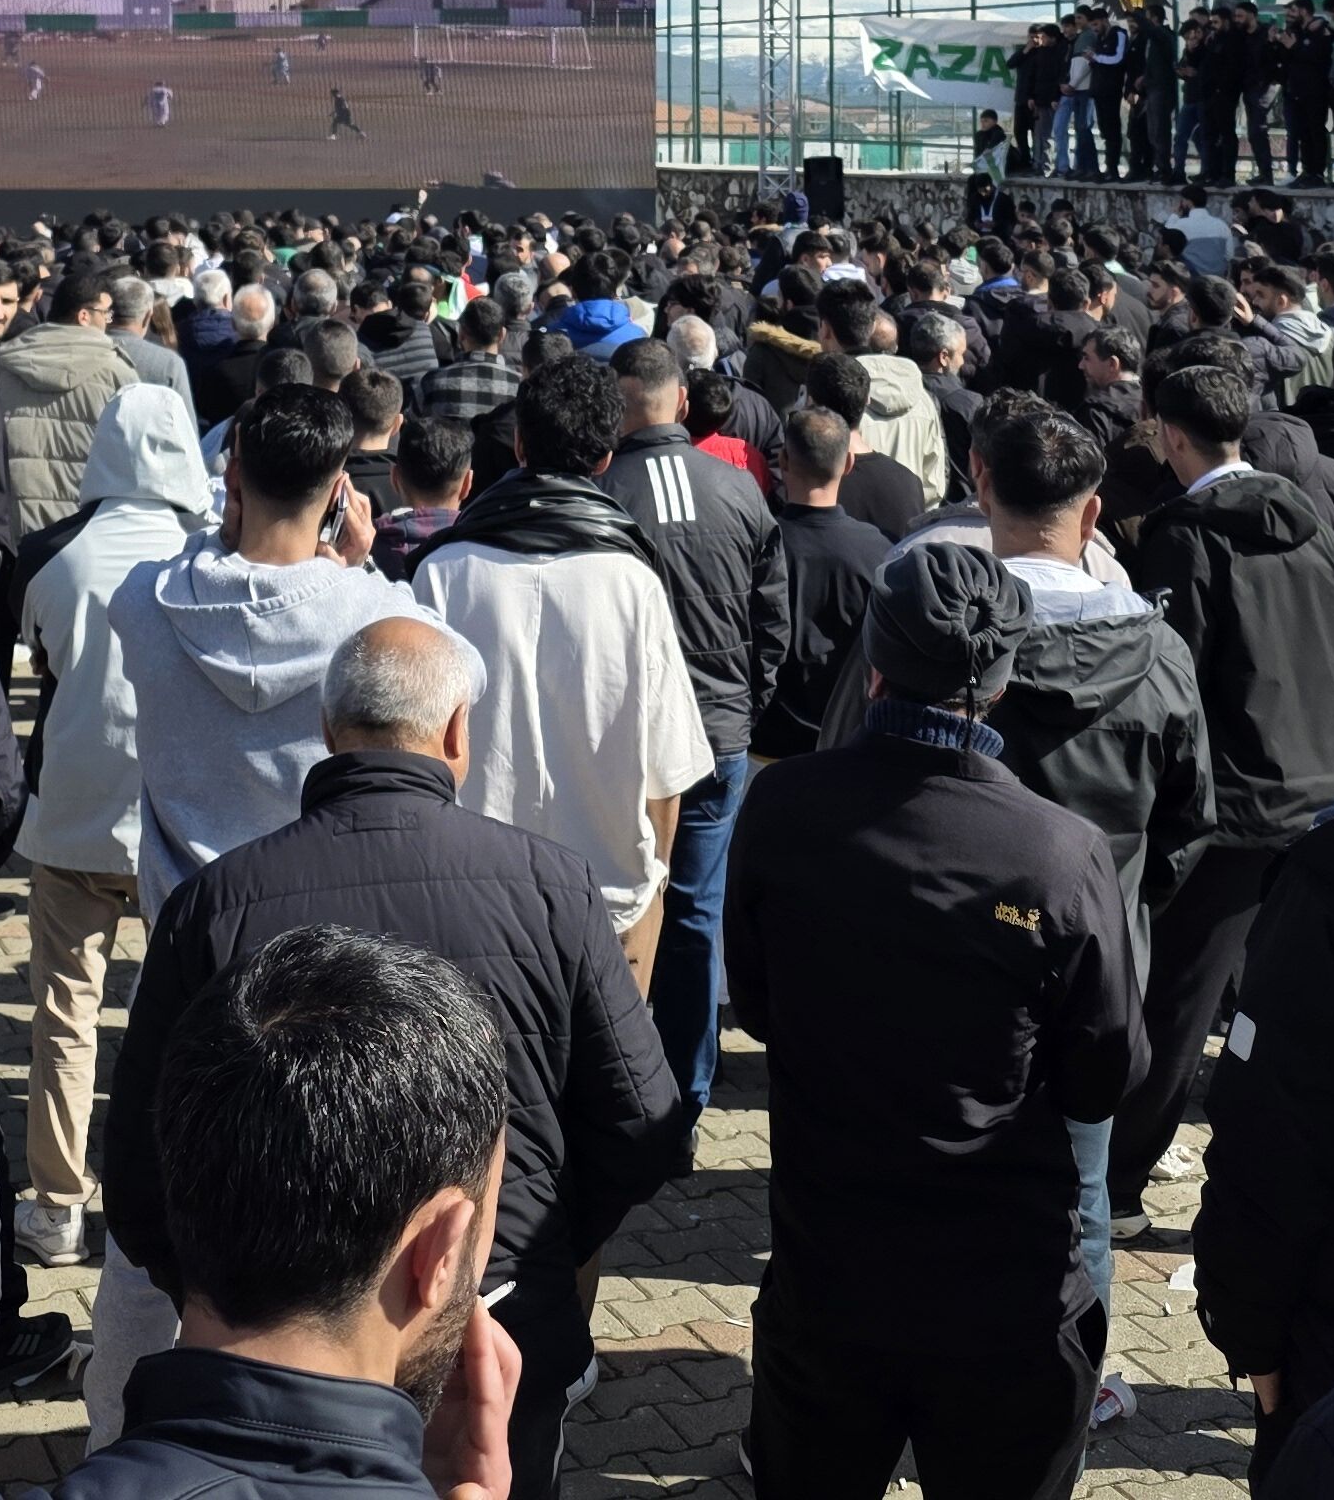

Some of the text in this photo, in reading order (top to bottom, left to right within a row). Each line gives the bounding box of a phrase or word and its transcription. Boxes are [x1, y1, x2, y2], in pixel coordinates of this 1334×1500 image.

[872, 36, 1026, 89] ZAZA
[994, 909, 1037, 931] Wolfskin
[995, 901, 1020, 918] Jack
